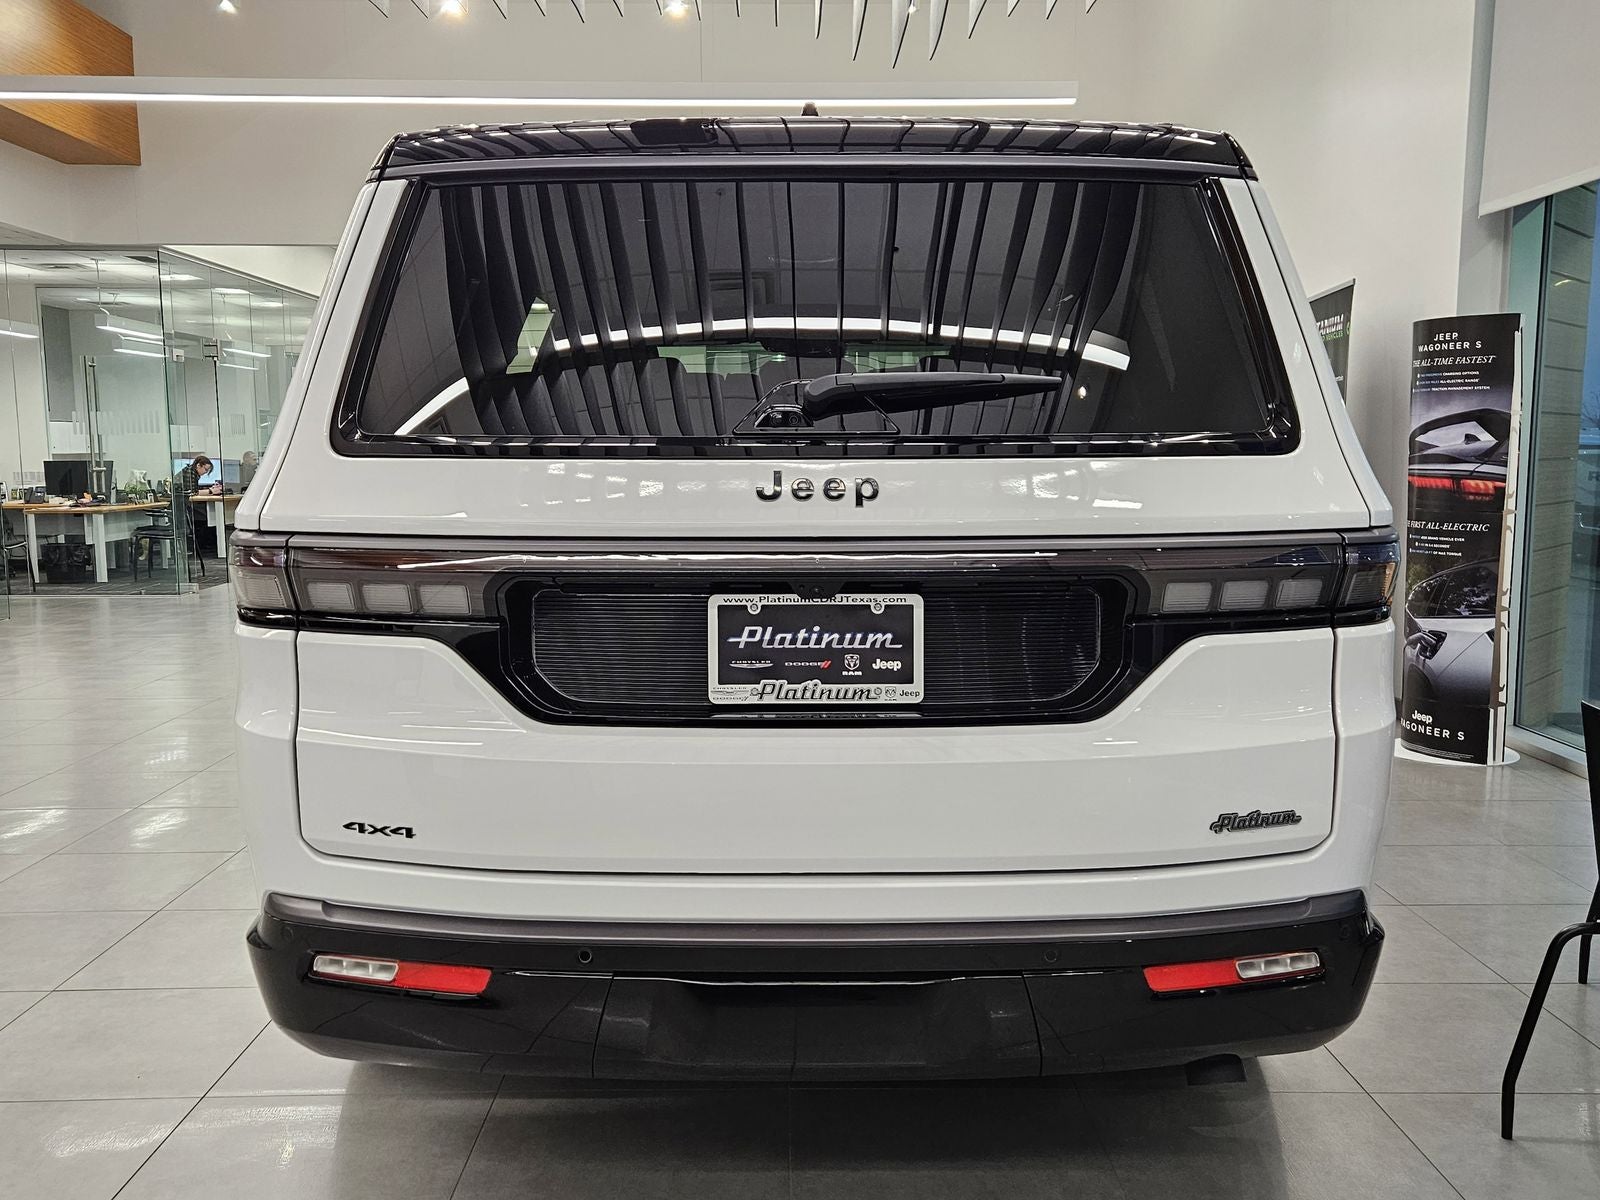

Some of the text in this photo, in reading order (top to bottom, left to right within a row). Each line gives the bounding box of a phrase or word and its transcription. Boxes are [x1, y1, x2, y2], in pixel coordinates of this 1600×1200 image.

[1433, 332, 1459, 341] JEEP
[1418, 340, 1482, 352] WAGONEER S
[1420, 356, 1455, 367] ALL-TIME
[1455, 355, 1496, 365] FASTEST
[756, 470, 879, 508] Jeep
[1426, 521, 1490, 532] ALL-ELECTRIC
[727, 625, 903, 649] Platinum
[872, 658, 902, 671] Jeep
[756, 680, 880, 701] Platinum
[899, 689, 920, 698] Jeep
[1411, 710, 1433, 724] Jeep
[1457, 731, 1465, 740] S
[1209, 809, 1302, 834] Platinum
